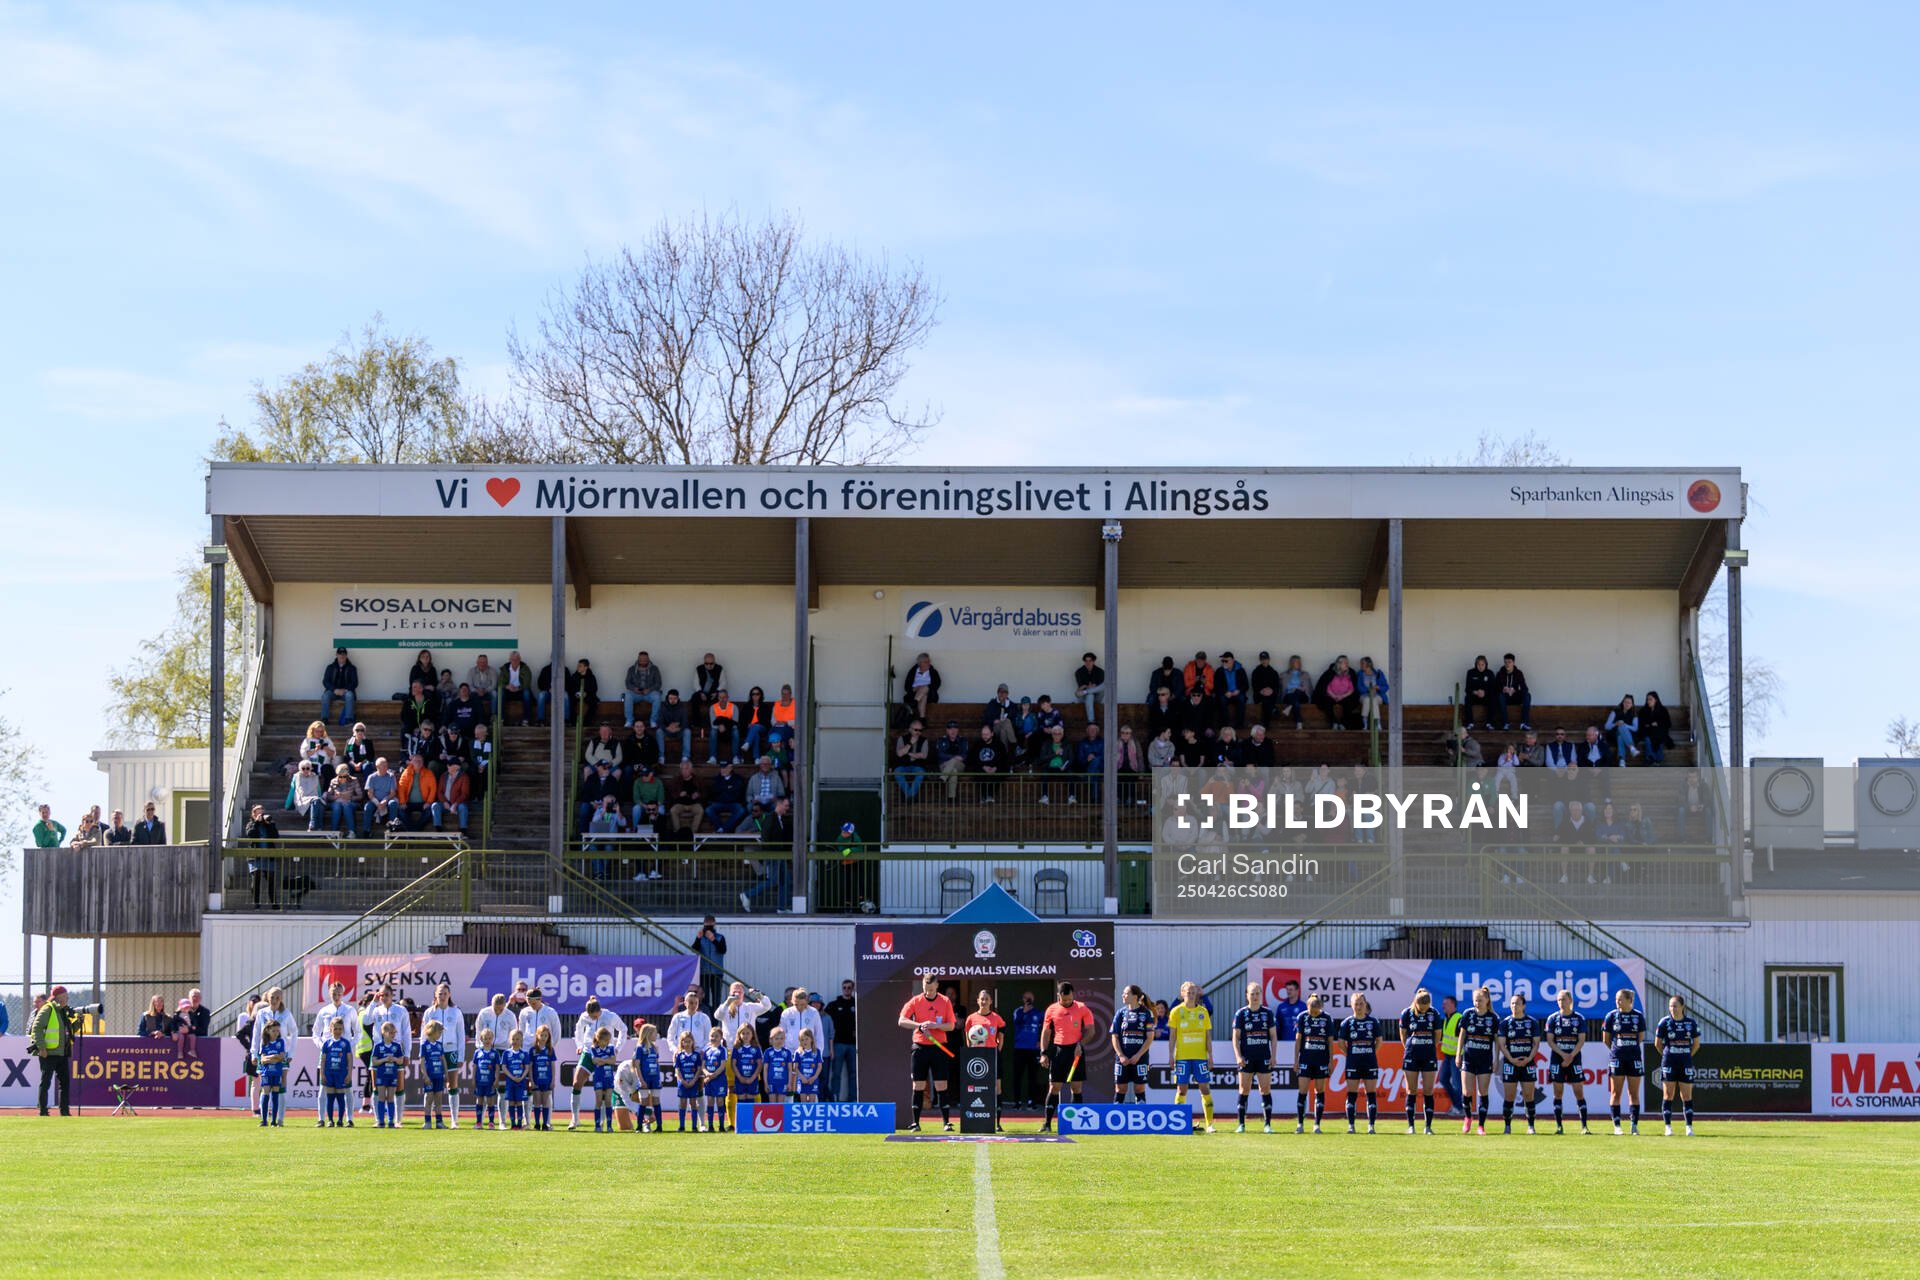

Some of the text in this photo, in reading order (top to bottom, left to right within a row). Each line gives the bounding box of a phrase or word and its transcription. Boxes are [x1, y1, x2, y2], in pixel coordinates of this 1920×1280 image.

[435, 478, 1269, 516] Vi Mjörnvallen och föreningslivet i Alingsås
[1510, 486, 1674, 505] Sparbanken Alingsås
[340, 598, 512, 613] SKOSALONGEN
[949, 606, 1082, 631] Vårgårdabuss
[398, 640, 453, 649] skosalongen.se
[1070, 948, 1102, 958] OBOS
[914, 965, 1057, 976] OBOS DAMALLSVENSKAN
[364, 971, 451, 986] SVENSKA
[511, 965, 663, 1004] Heja alla!
[1308, 976, 1396, 991] SVENSKA
[1455, 970, 1609, 1008] Heja dig!
[1308, 994, 1352, 1008] PEL
[72, 1056, 205, 1080] LÖFBERGS
[1271, 1070, 1290, 1085] Bil
[1831, 1096, 1853, 1107] ICA
[791, 1104, 878, 1118] SVENSKA
[791, 1119, 837, 1132] SPEL
[1105, 1110, 1187, 1131] OBOS
